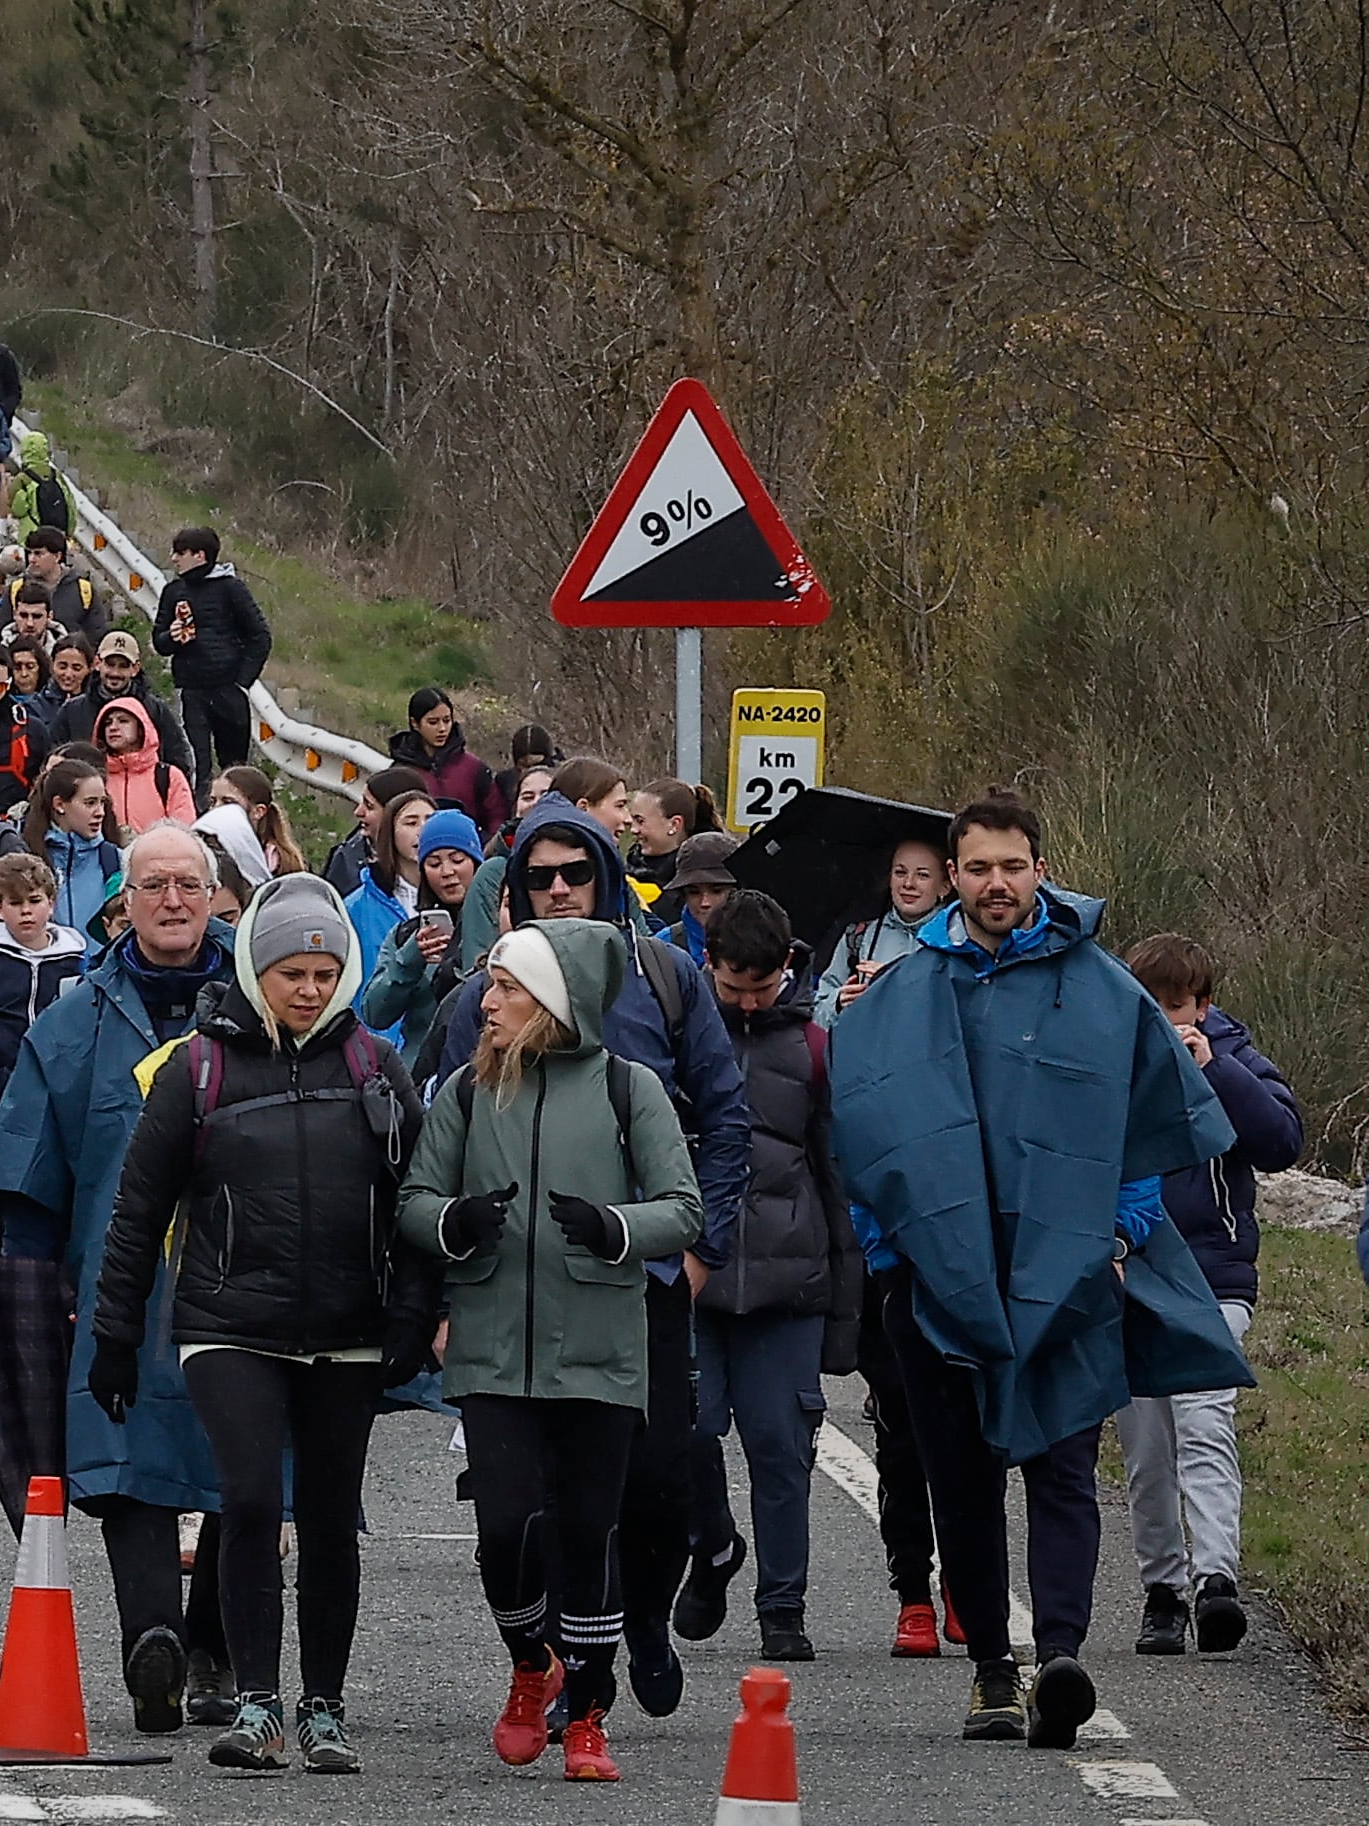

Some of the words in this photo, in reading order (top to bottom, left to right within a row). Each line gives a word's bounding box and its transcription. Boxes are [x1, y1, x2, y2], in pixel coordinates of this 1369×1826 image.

[640, 489, 713, 547] 9%
[737, 705, 821, 723] NA-2420
[759, 747, 795, 768] km
